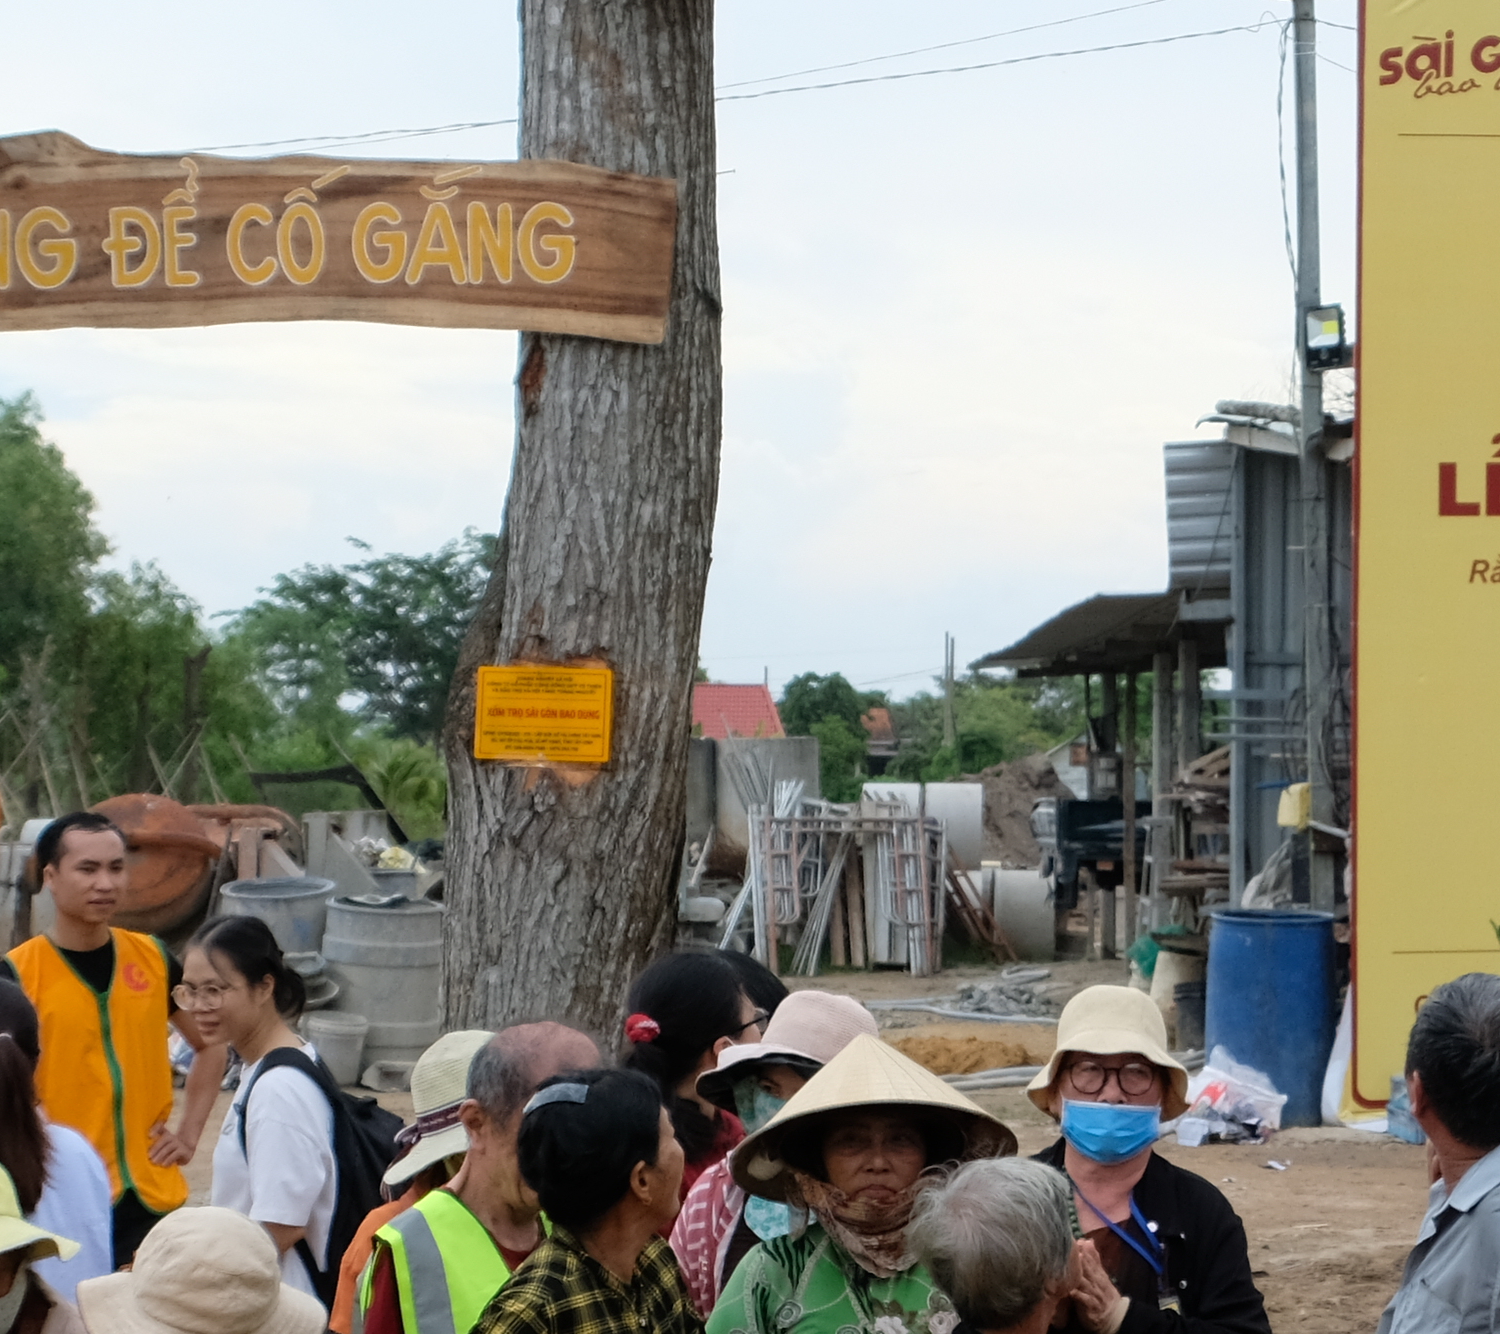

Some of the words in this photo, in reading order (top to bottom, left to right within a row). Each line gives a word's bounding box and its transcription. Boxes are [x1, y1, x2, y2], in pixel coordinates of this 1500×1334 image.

[1414, 70, 1481, 99] bao
[102, 158, 200, 287] ĐỂ
[225, 165, 351, 286] CỐ
[352, 165, 576, 287] GẮNG
